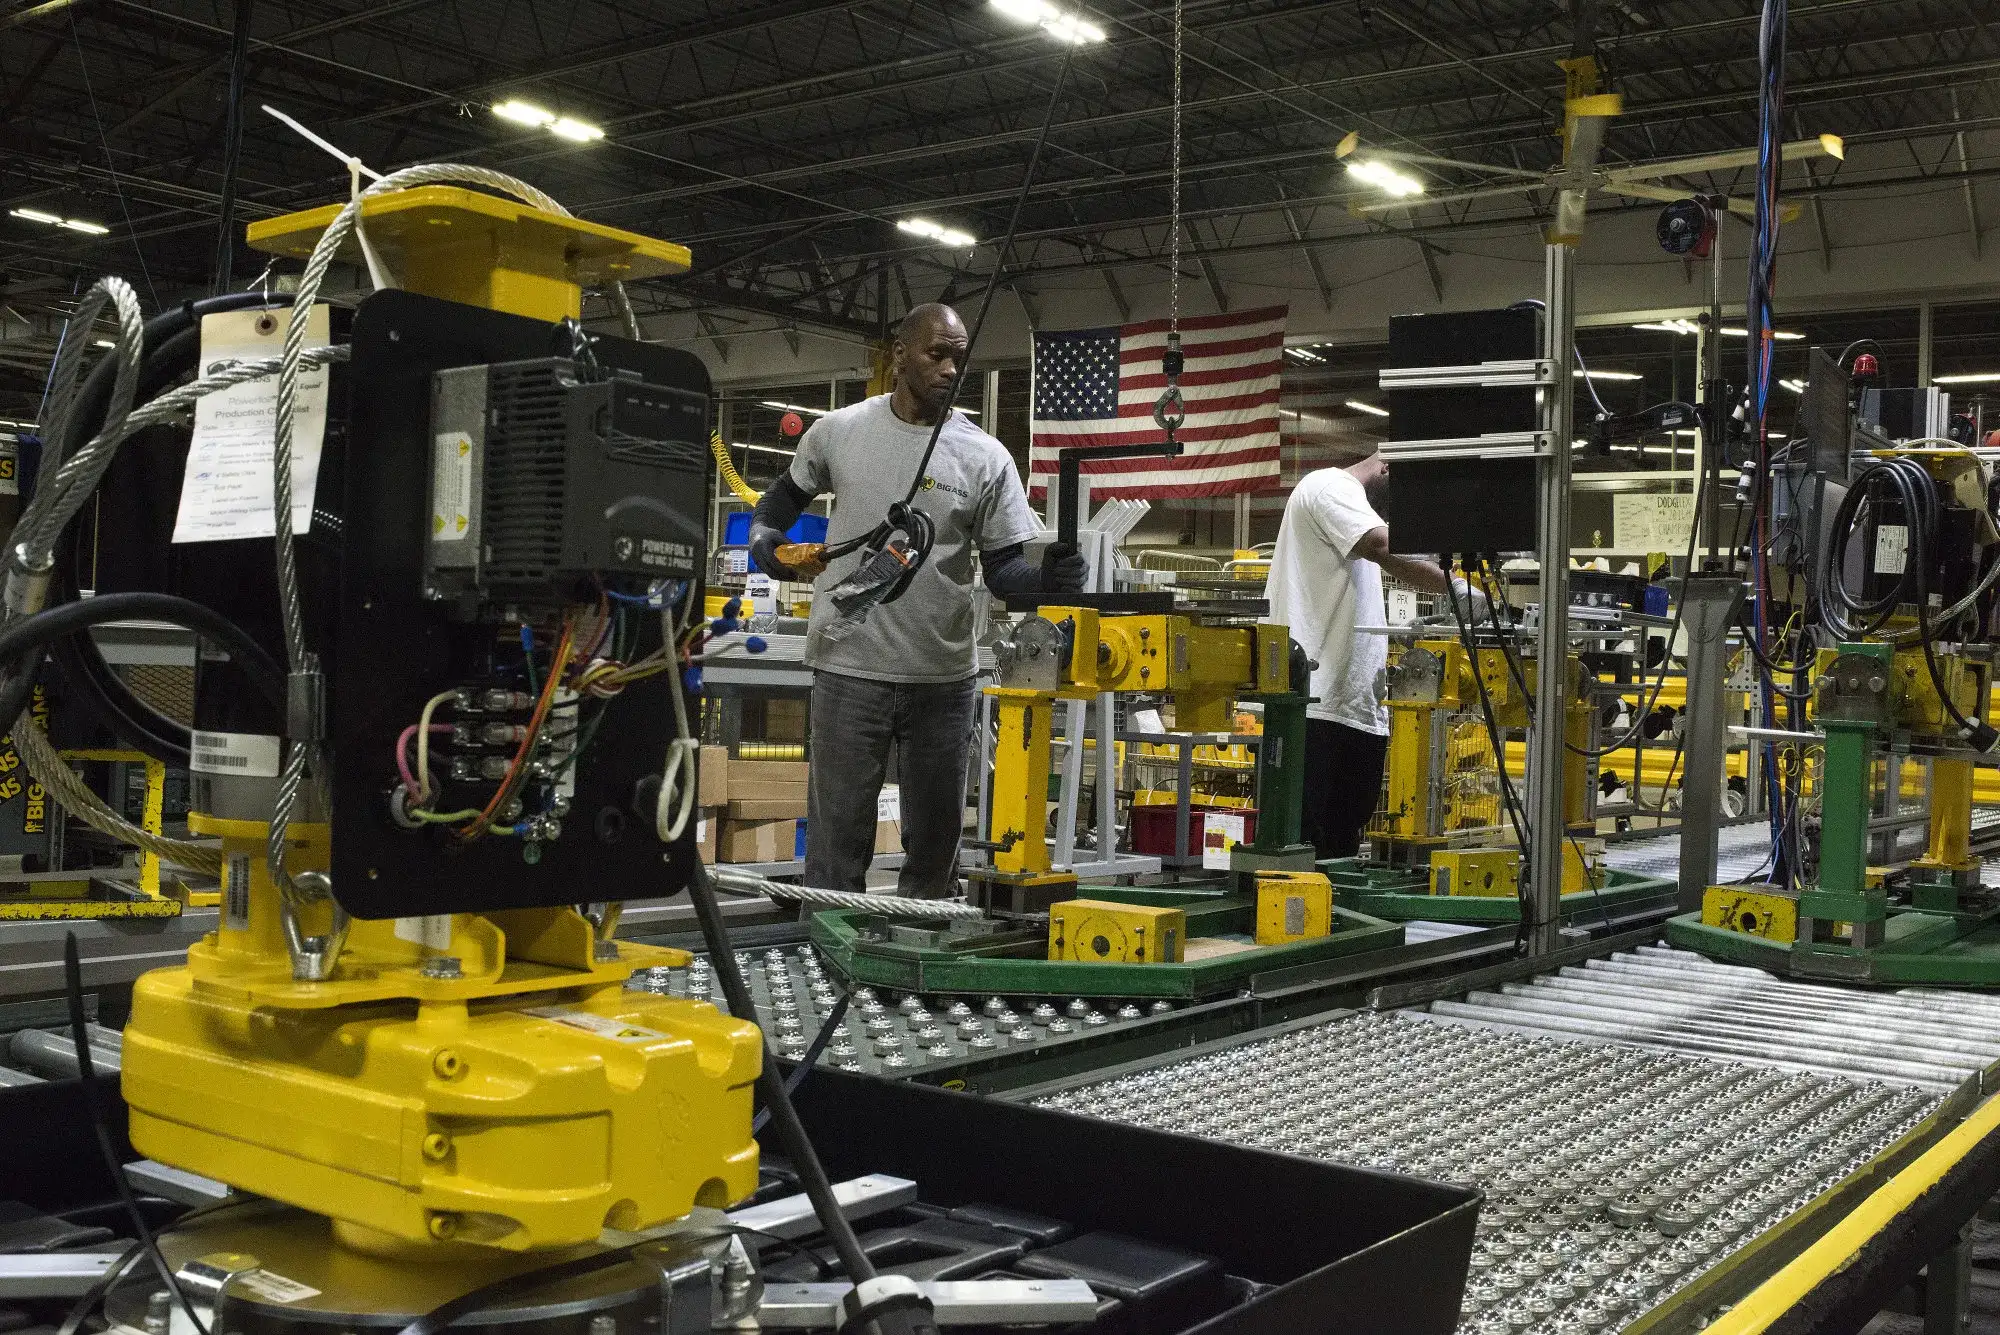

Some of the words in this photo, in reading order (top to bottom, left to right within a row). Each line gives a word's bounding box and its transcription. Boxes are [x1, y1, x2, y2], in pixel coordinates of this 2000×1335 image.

[215, 408, 265, 419] Production
[936, 482, 952, 492] BIG
[951, 487, 969, 498] ASS
[26, 782, 46, 821] BIG
